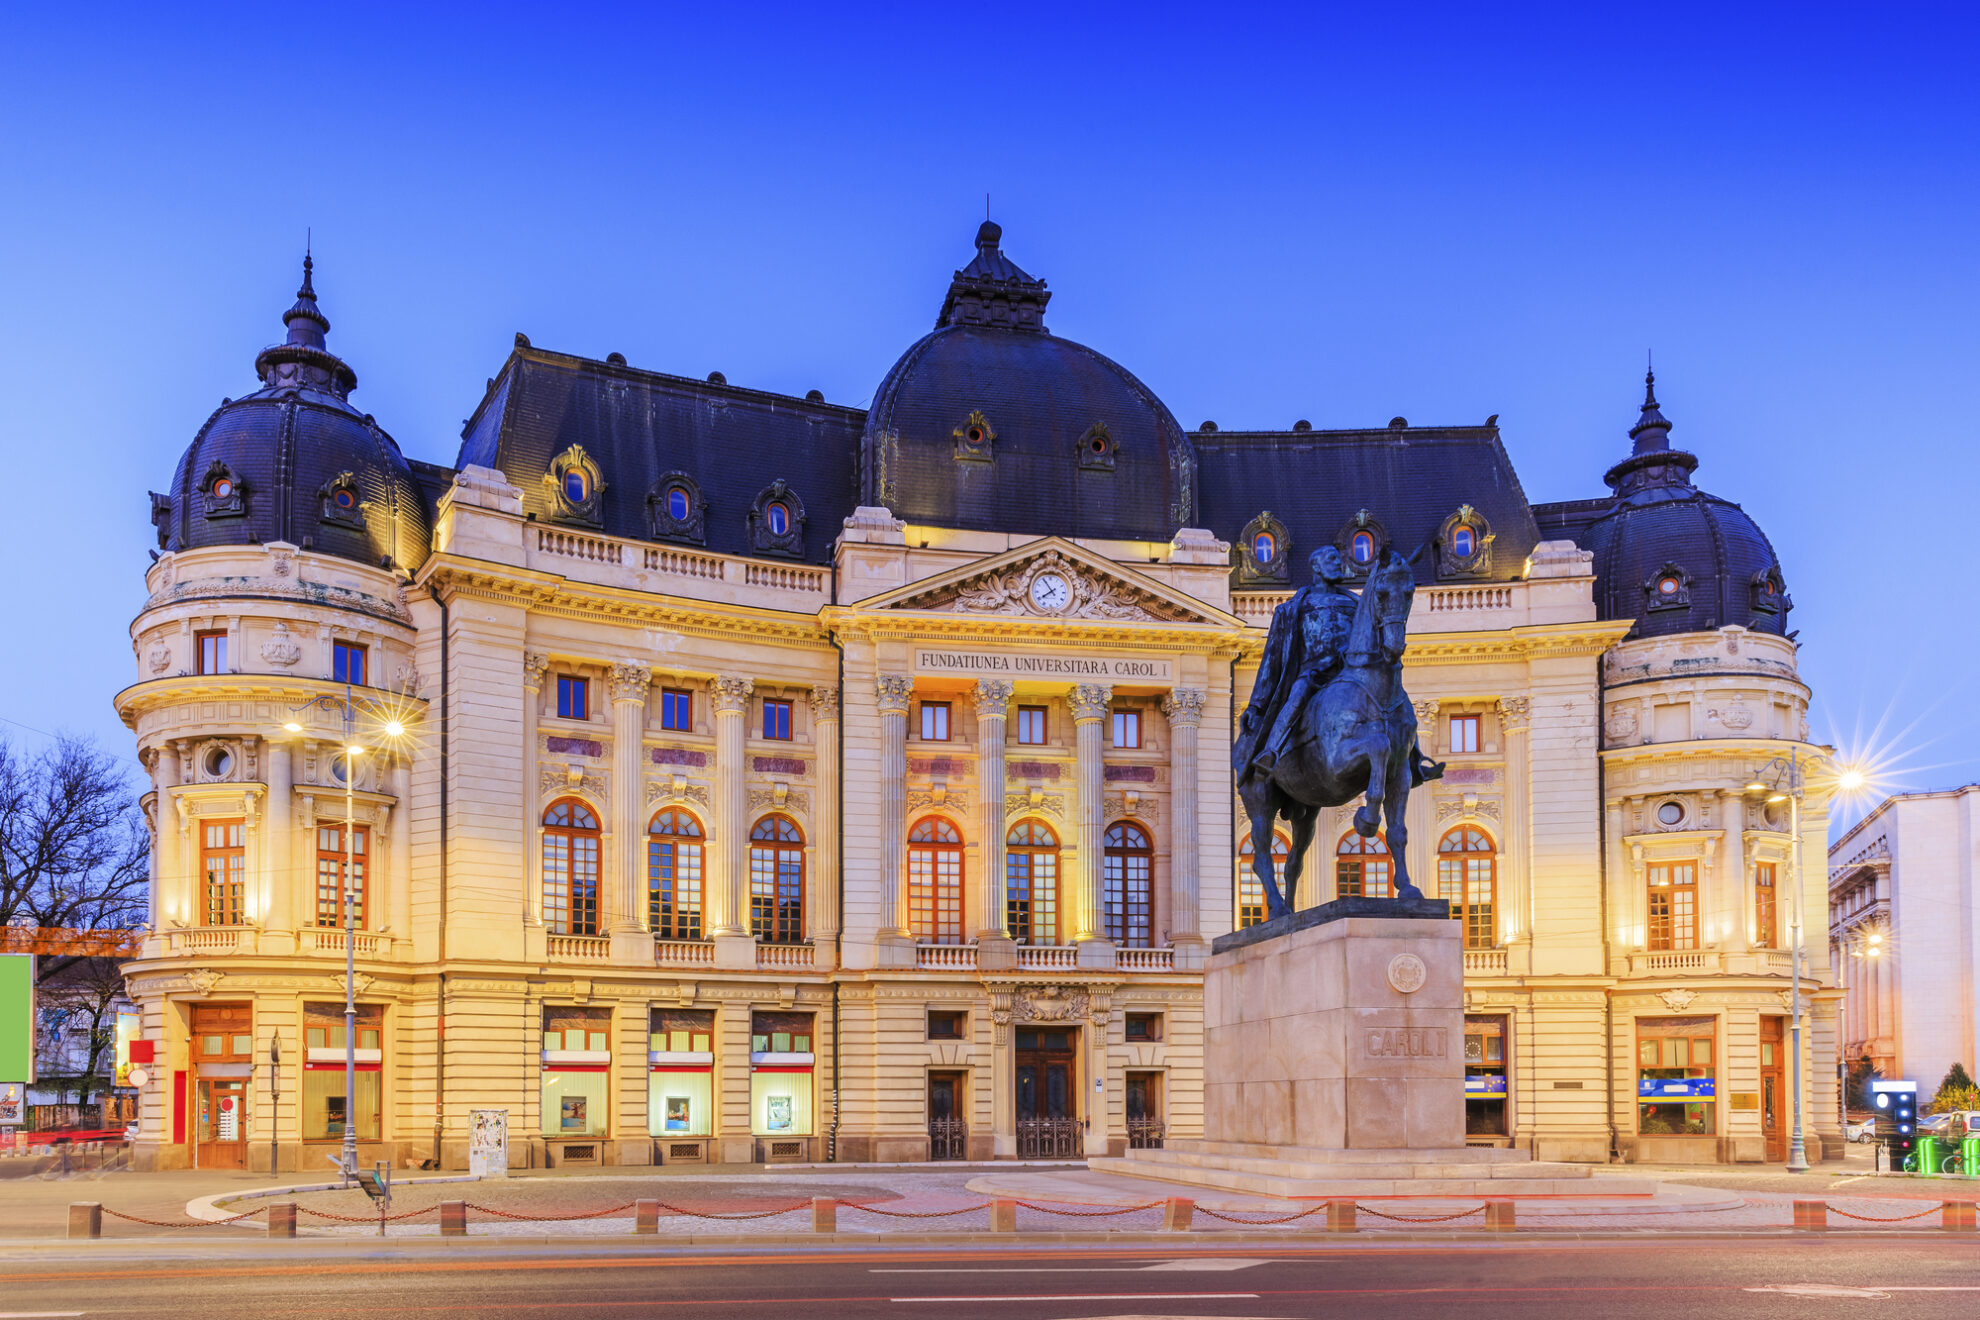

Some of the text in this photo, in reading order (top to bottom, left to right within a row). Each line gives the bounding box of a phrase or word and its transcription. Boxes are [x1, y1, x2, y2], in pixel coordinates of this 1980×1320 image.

[921, 653, 1009, 670] FUNDATIUNEA
[1114, 661, 1158, 676] CAROL
[1162, 664, 1167, 677] I
[1367, 1030, 1433, 1056] CAROL
